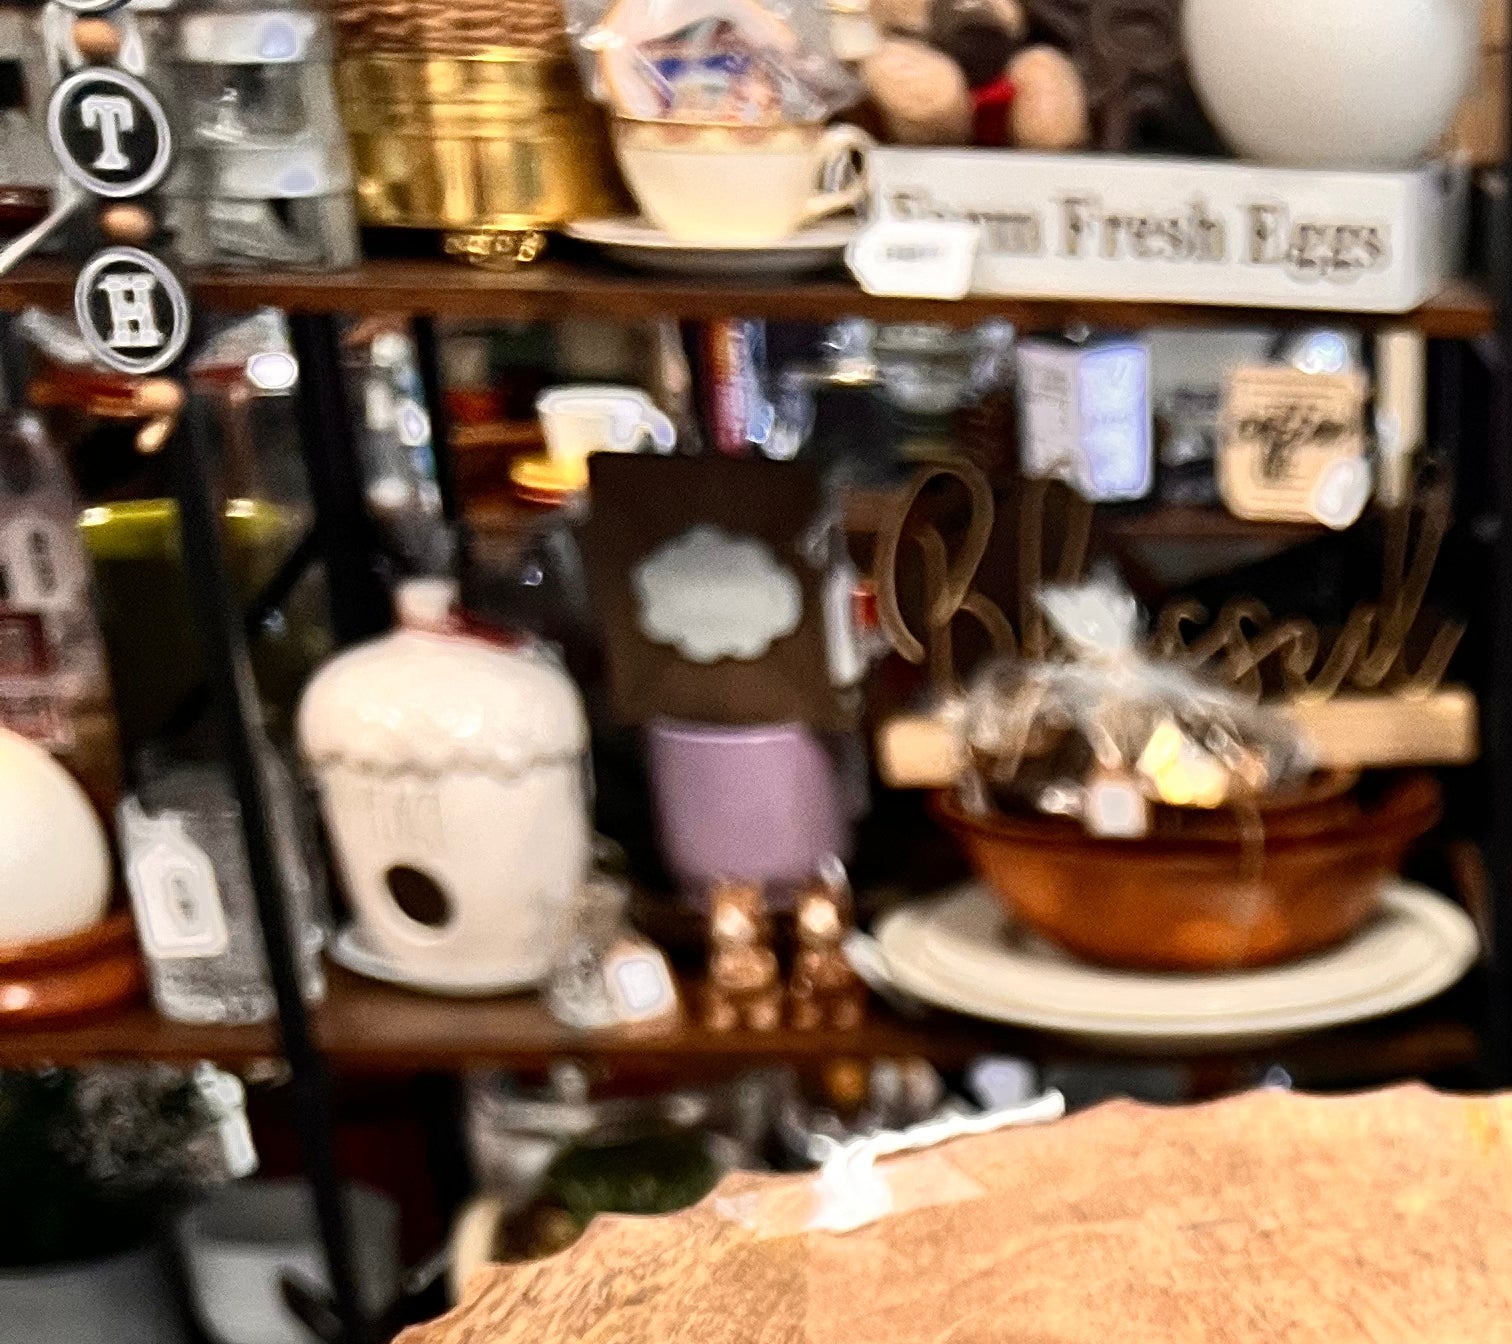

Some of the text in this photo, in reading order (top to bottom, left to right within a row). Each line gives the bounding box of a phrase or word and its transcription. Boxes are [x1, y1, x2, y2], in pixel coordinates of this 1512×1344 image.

[80, 95, 134, 170] T
[1061, 197, 1224, 262] Fresh
[1243, 203, 1388, 281] Eggs
[98, 272, 164, 347] H
